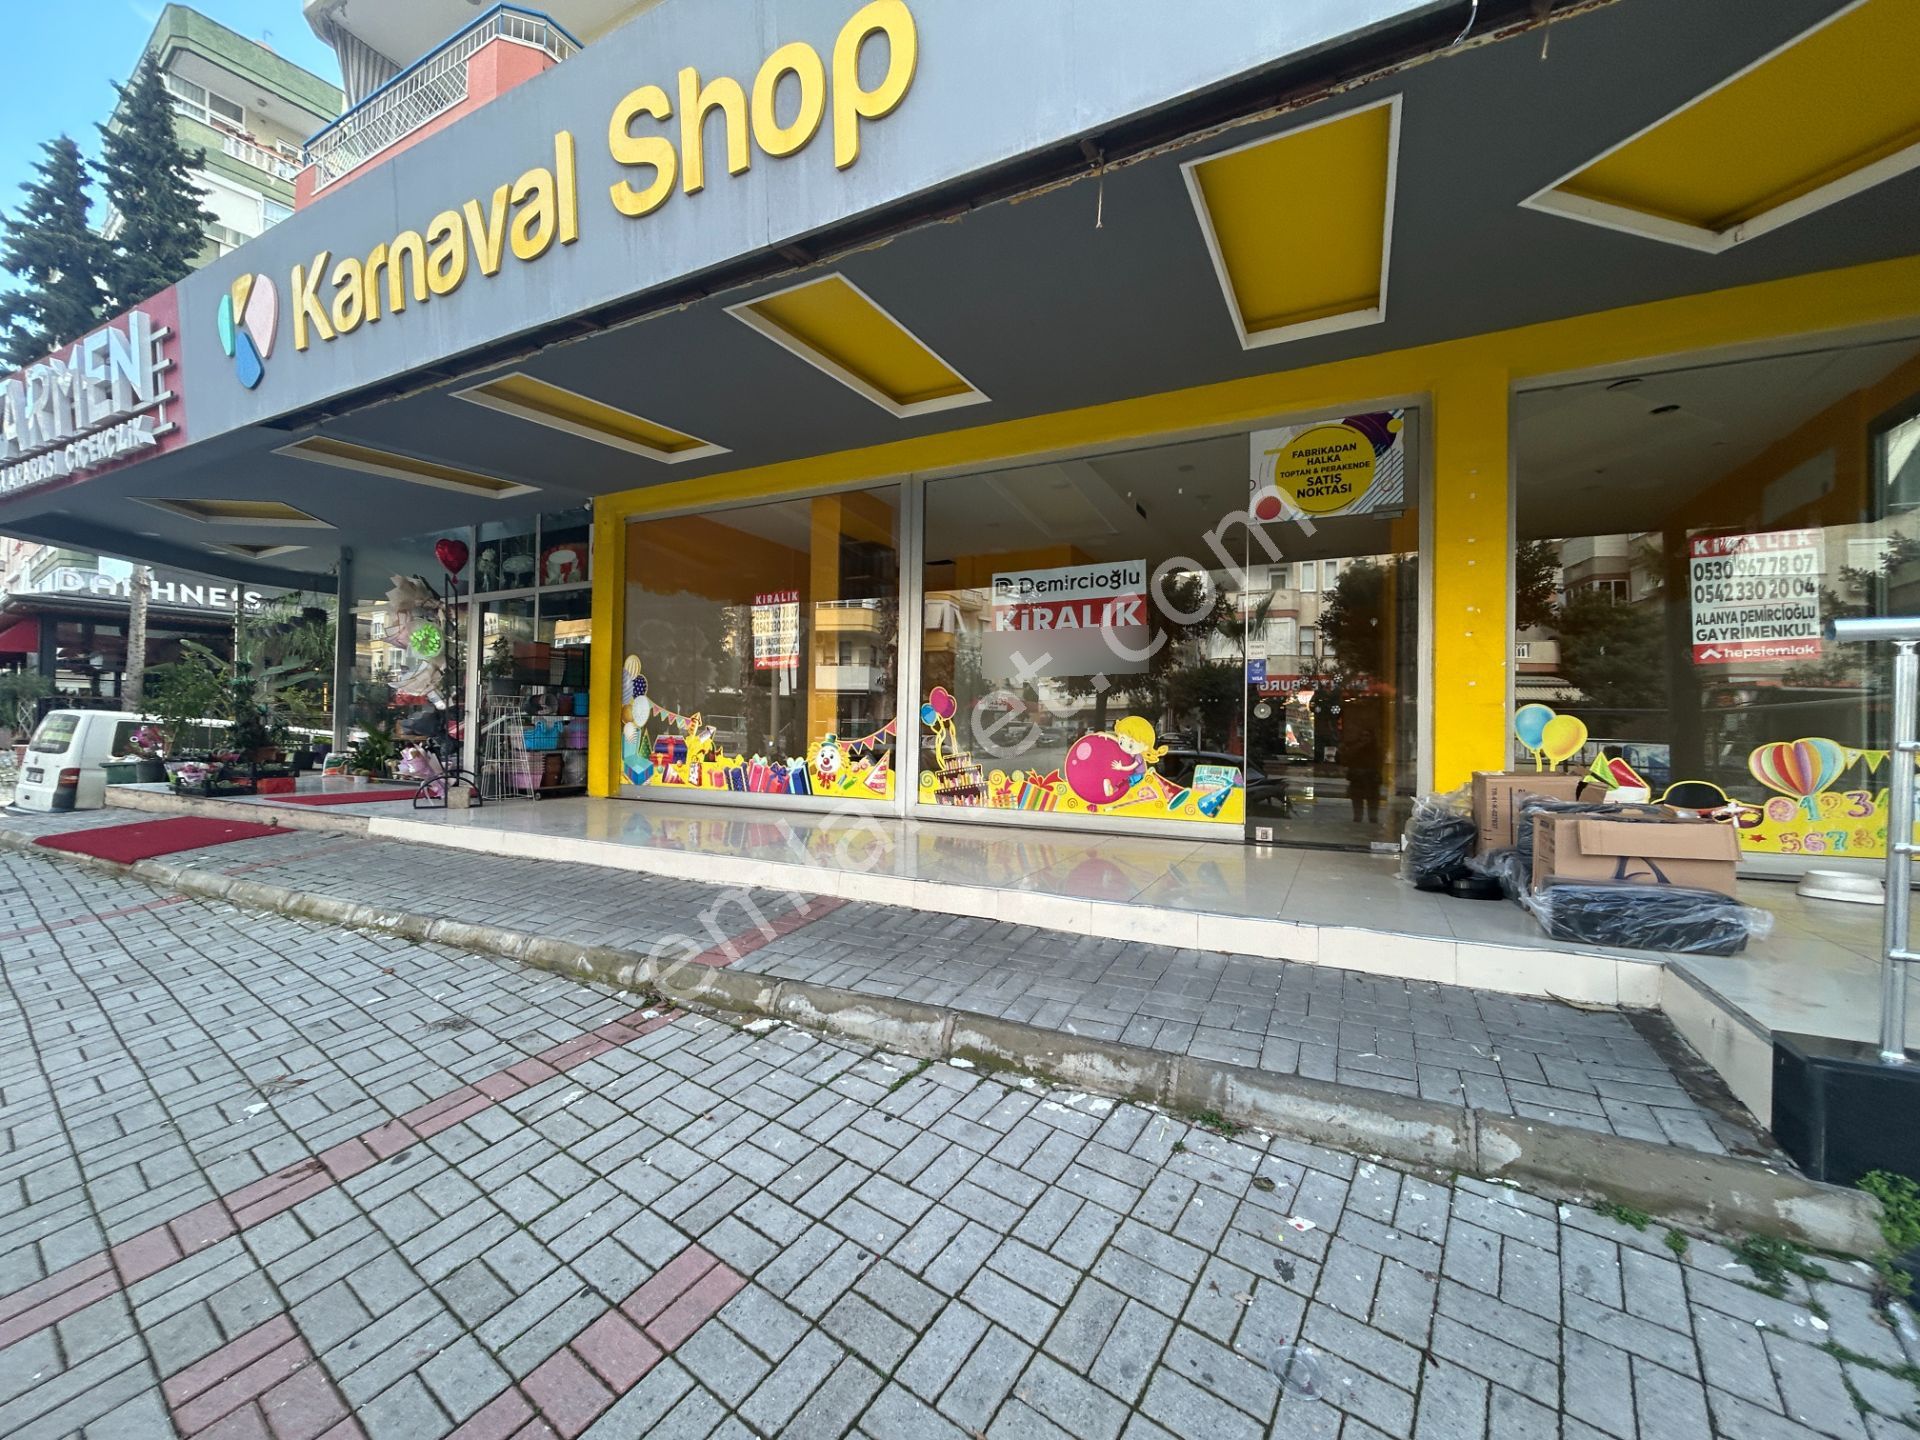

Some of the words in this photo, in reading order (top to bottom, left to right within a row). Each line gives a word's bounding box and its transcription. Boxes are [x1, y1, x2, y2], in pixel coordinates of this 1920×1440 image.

[290, 131, 579, 351] Karnaval
[608, 0, 918, 219] Shop
[1291, 442, 1357, 459] FABRİKADAN
[1280, 468, 1311, 478] TOPTAN
[1321, 460, 1371, 473] PERAKENDE
[1306, 454, 1341, 466] HALKA
[1306, 473, 1342, 487] SATIŞ
[1296, 483, 1352, 499] NOKTASI
[1694, 560, 1734, 581] 0530
[1792, 553, 1814, 574] 07
[1018, 569, 1140, 594] Demircioğlu
[756, 591, 798, 605] KİRALIK
[1694, 582, 1734, 604] 0542
[1736, 581, 1766, 601] 330
[1769, 579, 1790, 599] 20
[995, 600, 1142, 632] KİRALIK
[1696, 610, 1738, 626] ALANYA
[1740, 603, 1816, 623] DEMİRCİOĞLU
[1696, 623, 1817, 642] GAYRİMENKUL
[1724, 644, 1815, 659] hepsiemlak
